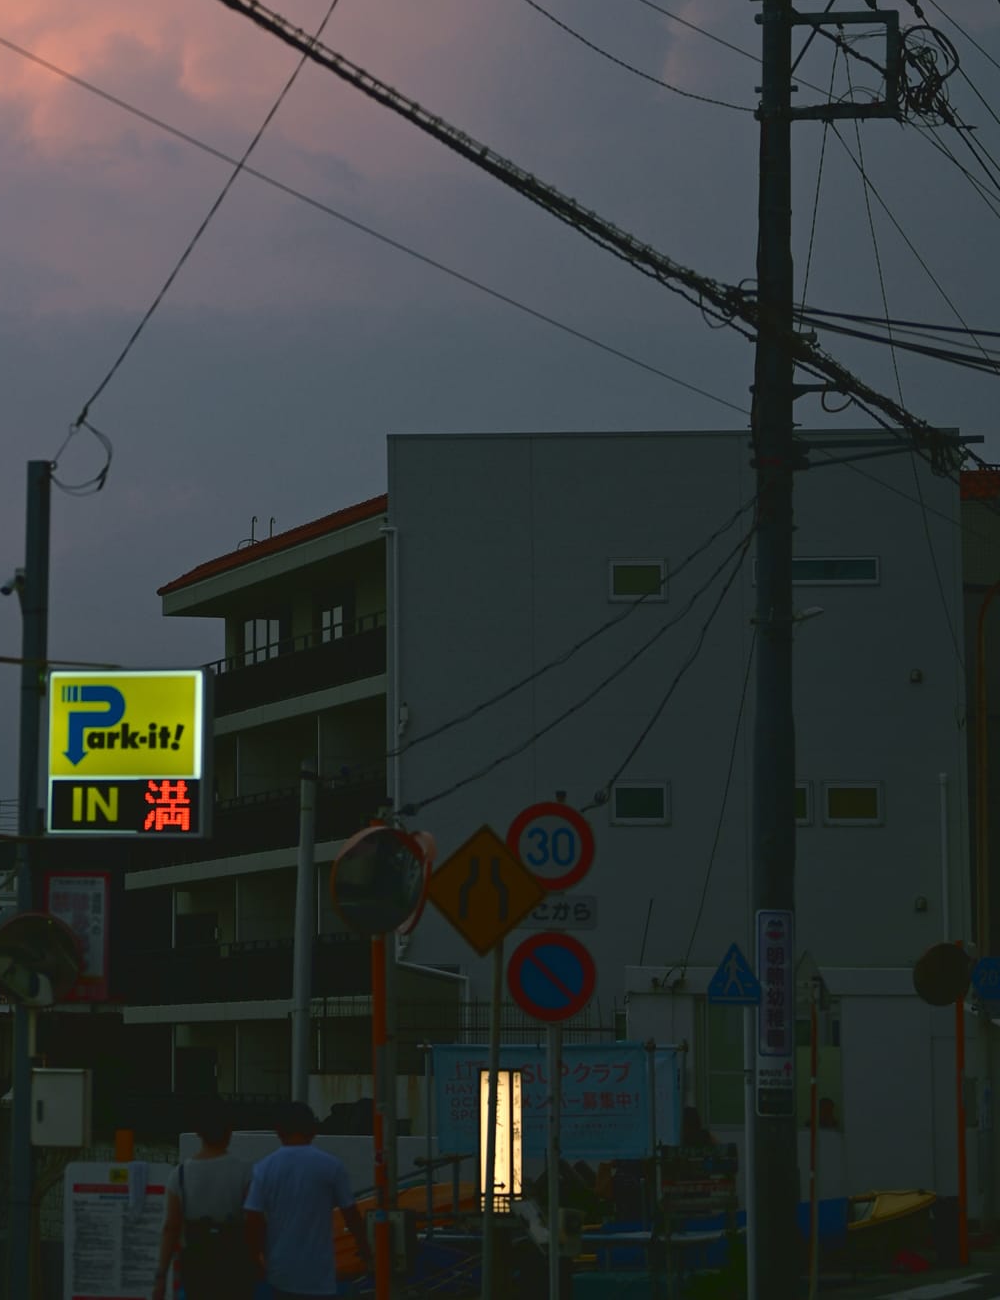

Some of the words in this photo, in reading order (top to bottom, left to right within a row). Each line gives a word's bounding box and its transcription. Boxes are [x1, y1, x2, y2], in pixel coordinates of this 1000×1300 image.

[72, 786, 119, 822] IN
[144, 779, 191, 831] 満
[527, 827, 575, 866] 30
[531, 902, 592, 922] こから
